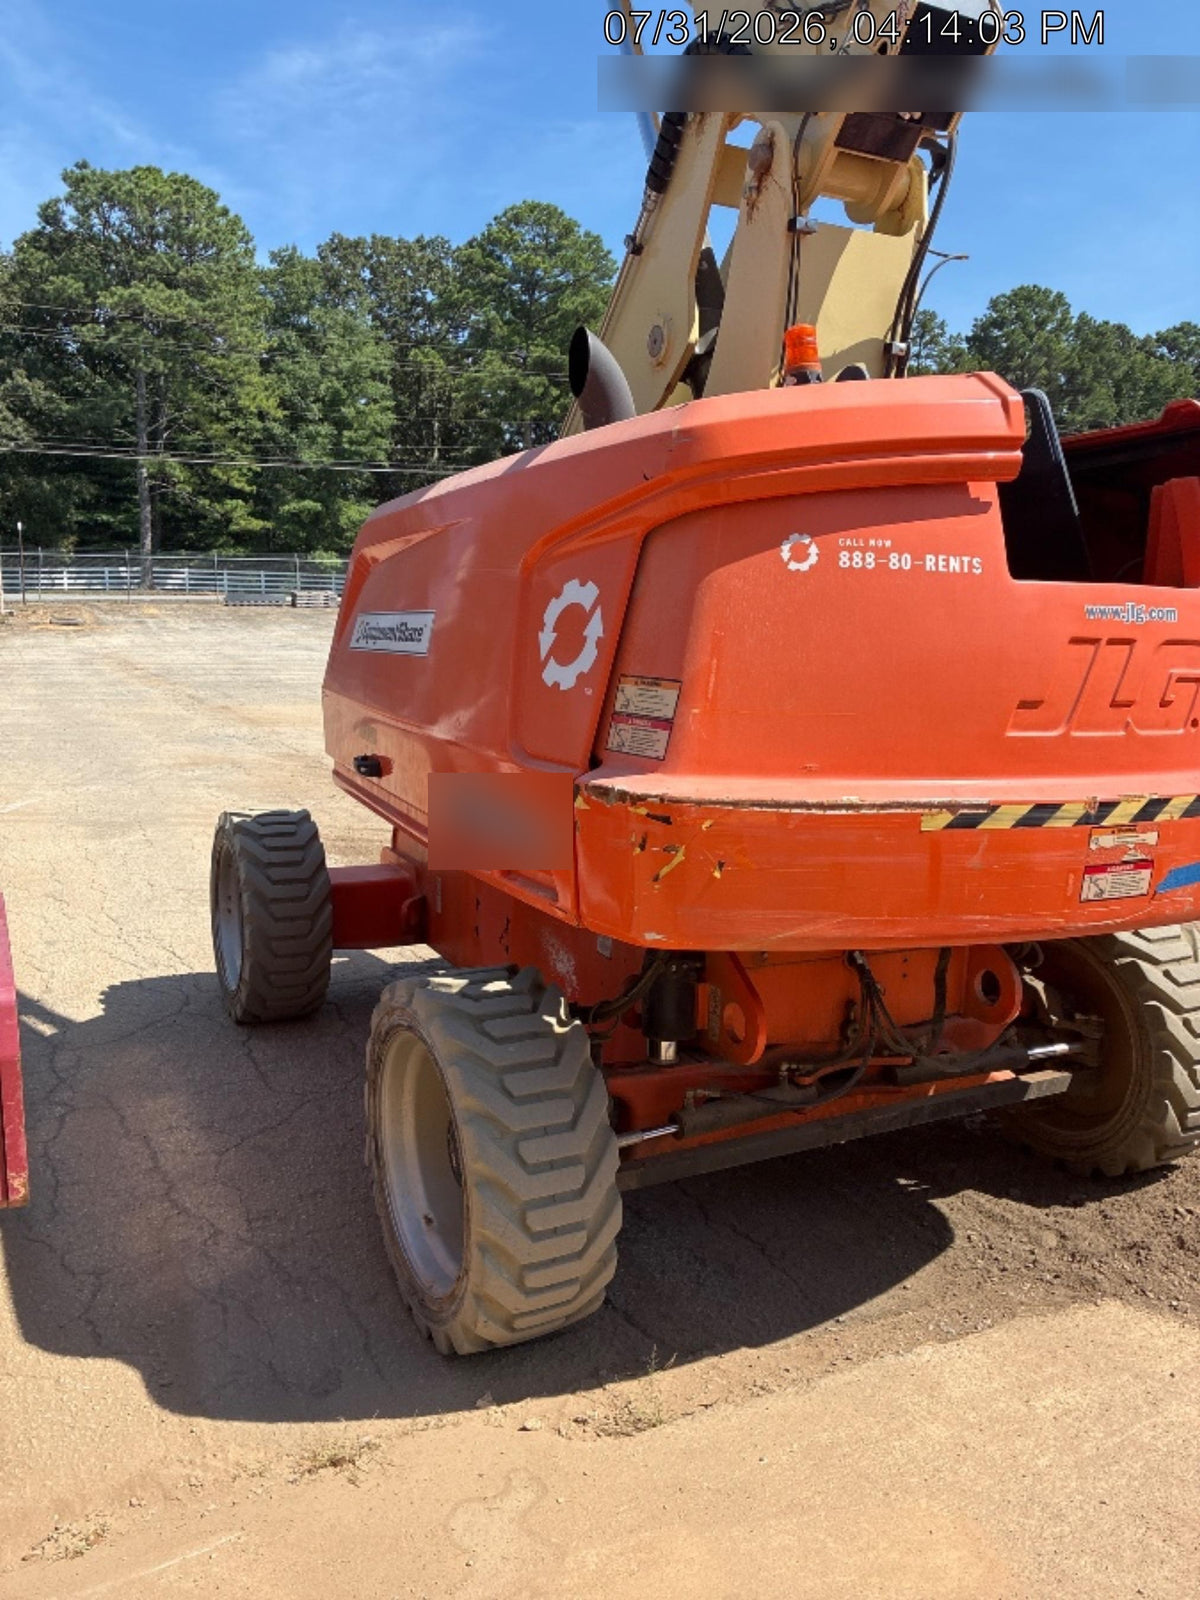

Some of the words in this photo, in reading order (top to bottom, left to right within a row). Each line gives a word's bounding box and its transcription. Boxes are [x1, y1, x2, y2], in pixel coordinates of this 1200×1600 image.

[838, 537, 865, 547] CALL
[869, 539, 892, 548] NOW
[838, 550, 983, 575] 888-80-RENTS
[1084, 602, 1178, 624] www.jlg.com
